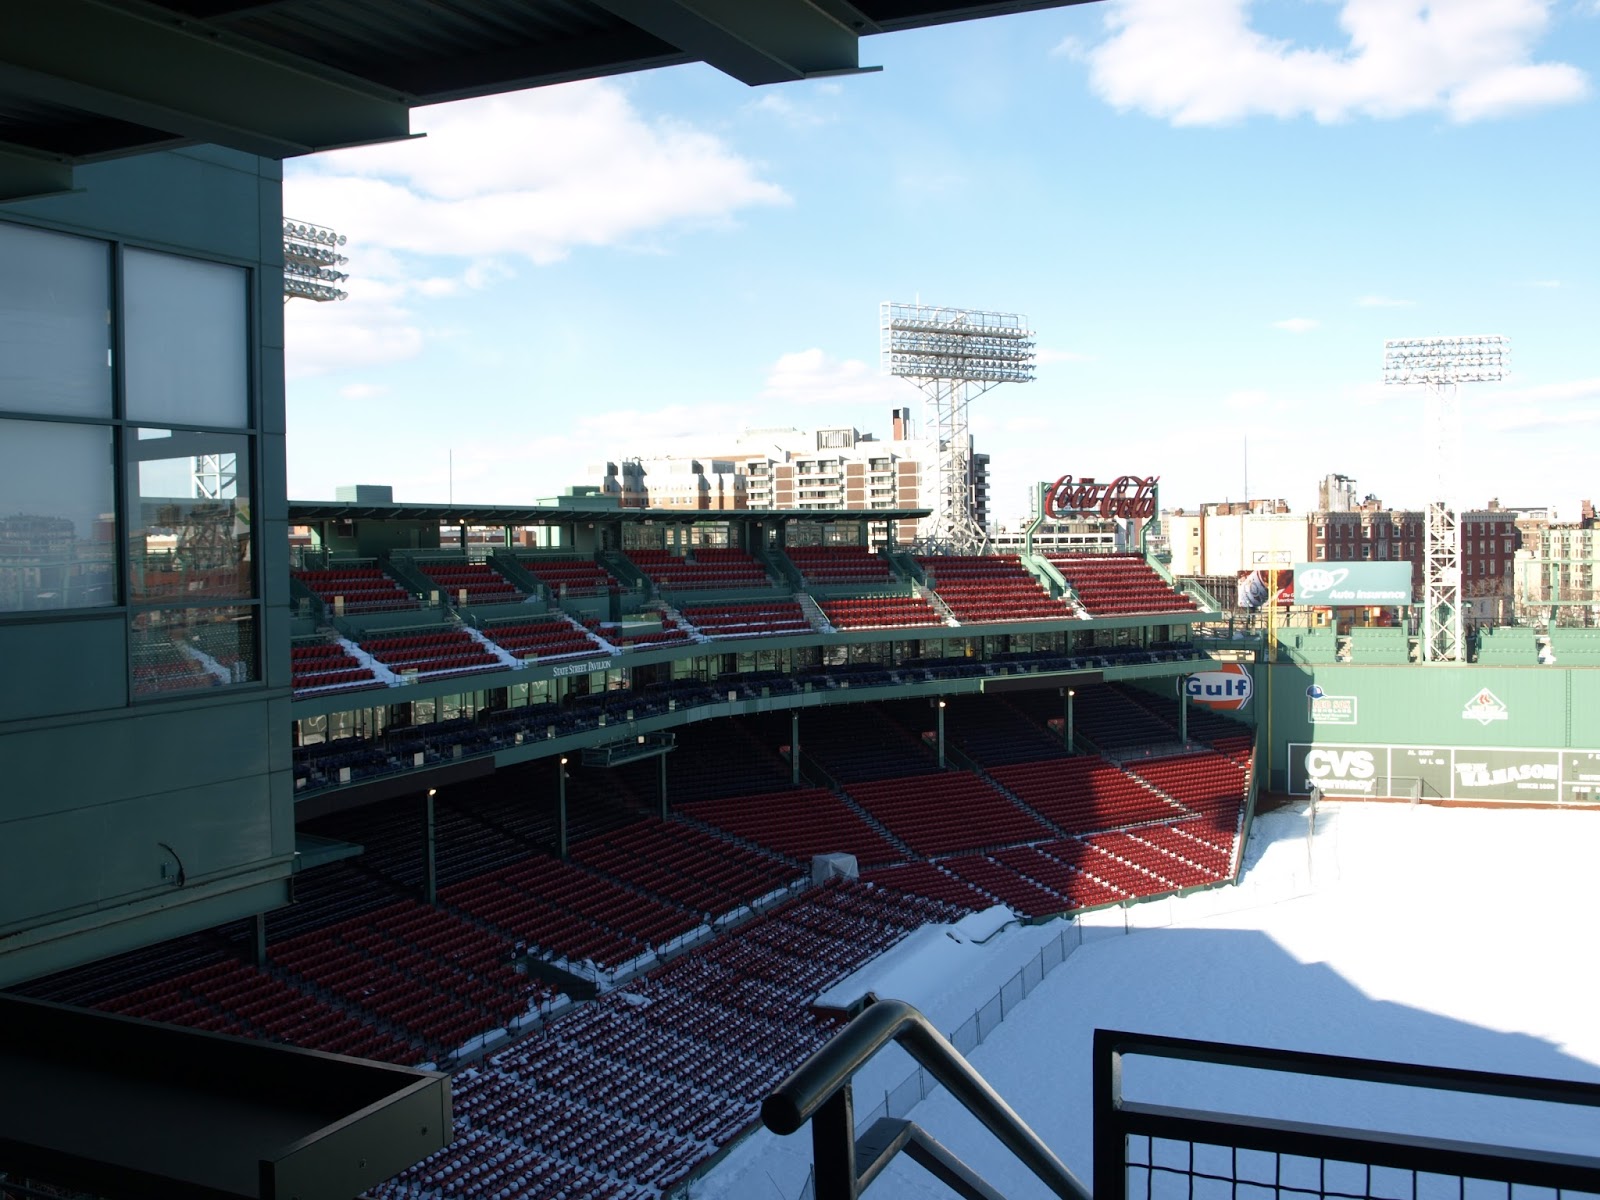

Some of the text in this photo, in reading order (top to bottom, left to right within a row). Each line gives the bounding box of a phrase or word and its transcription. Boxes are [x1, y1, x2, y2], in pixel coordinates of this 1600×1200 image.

[1045, 475, 1160, 519] Coca-Cola
[1328, 589, 1406, 599] Auto Insurance
[553, 660, 611, 677] STATE STREET PAVILION
[1185, 676, 1247, 696] Gulf
[1313, 700, 1351, 709] RED SOX
[1304, 749, 1375, 778] CVS
[1305, 776, 1372, 792] pharmacy
